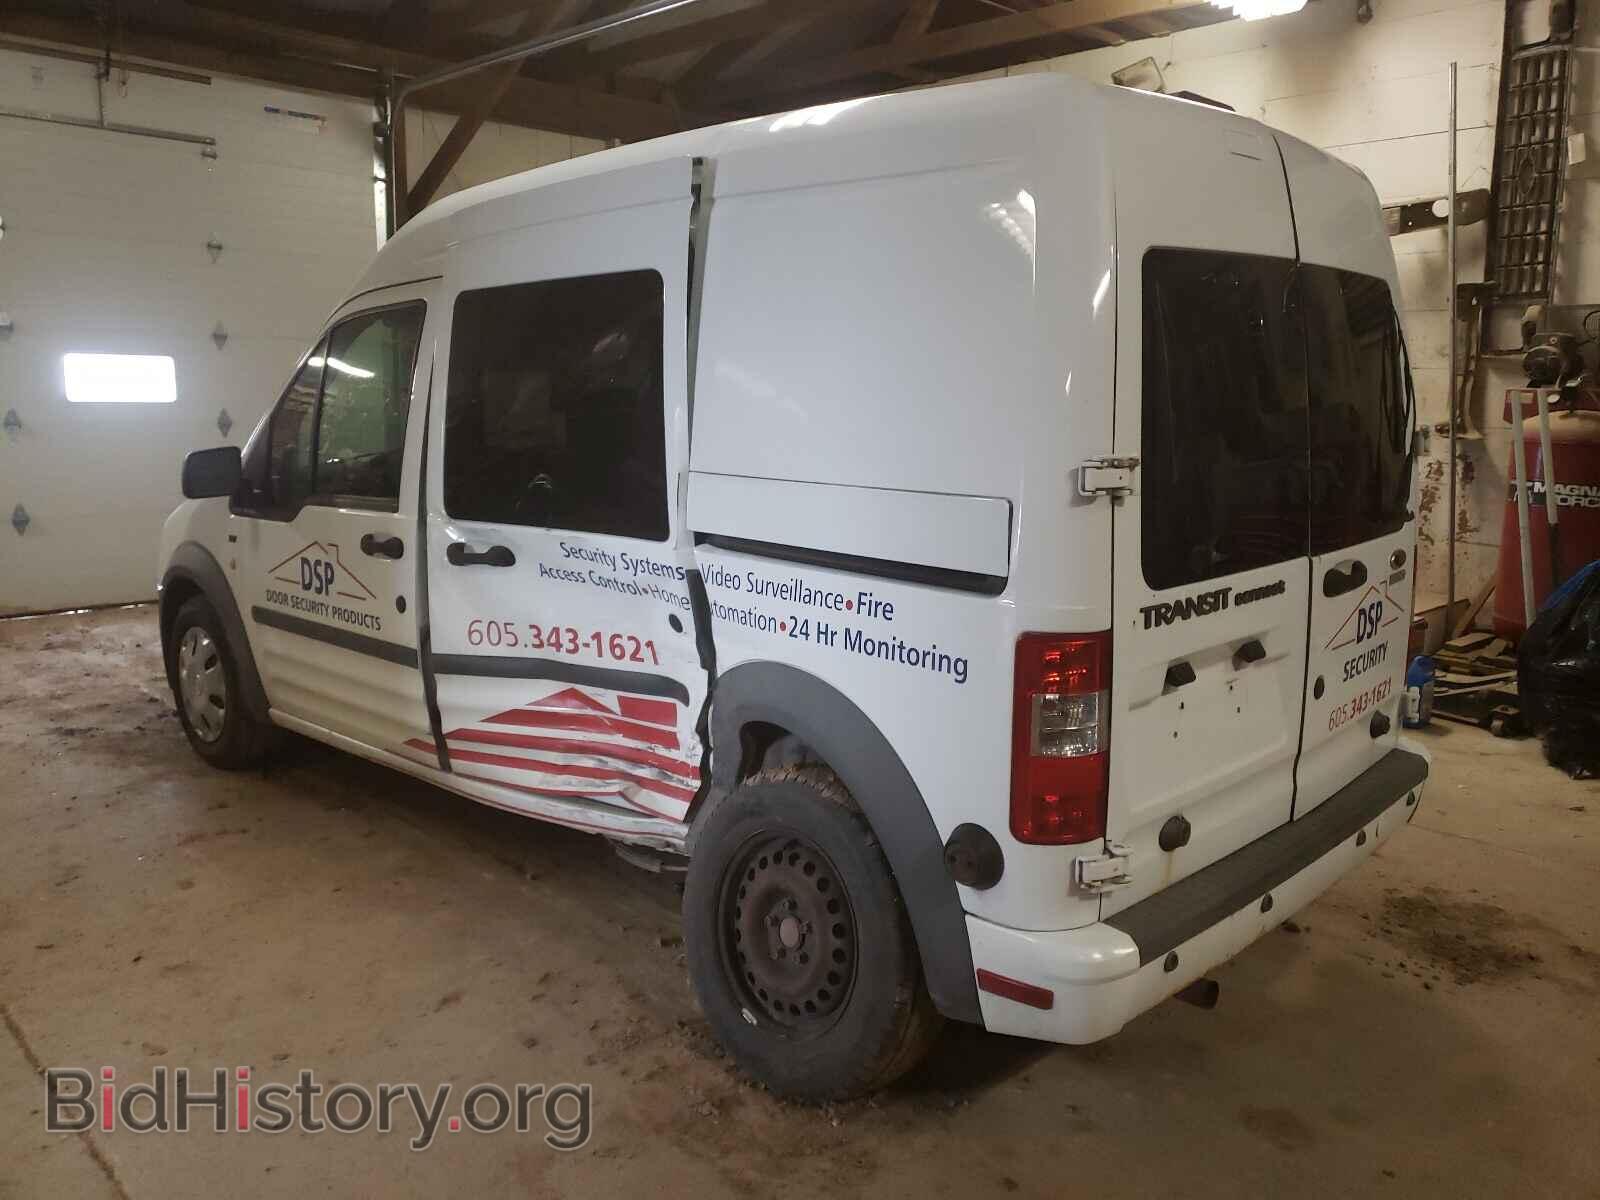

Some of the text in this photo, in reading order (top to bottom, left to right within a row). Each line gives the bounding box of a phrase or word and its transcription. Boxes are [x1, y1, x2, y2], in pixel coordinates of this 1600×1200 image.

[300, 556, 335, 597] DSP
[560, 541, 894, 621] Security Systems Video Surveillance Fire
[265, 589, 381, 631] DOOR SECURITY PRODUCTS
[538, 562, 586, 584] Access
[588, 570, 642, 597] Control
[788, 615, 810, 641] 24
[816, 621, 838, 647] Hr
[844, 627, 968, 684] Monitoring
[1139, 586, 1233, 630] TRANSIT
[1356, 600, 1383, 645] DSP
[467, 618, 659, 666] 605.343-1621
[1342, 640, 1389, 683] SECURITY
[1328, 676, 1393, 732] 605.343-1621
